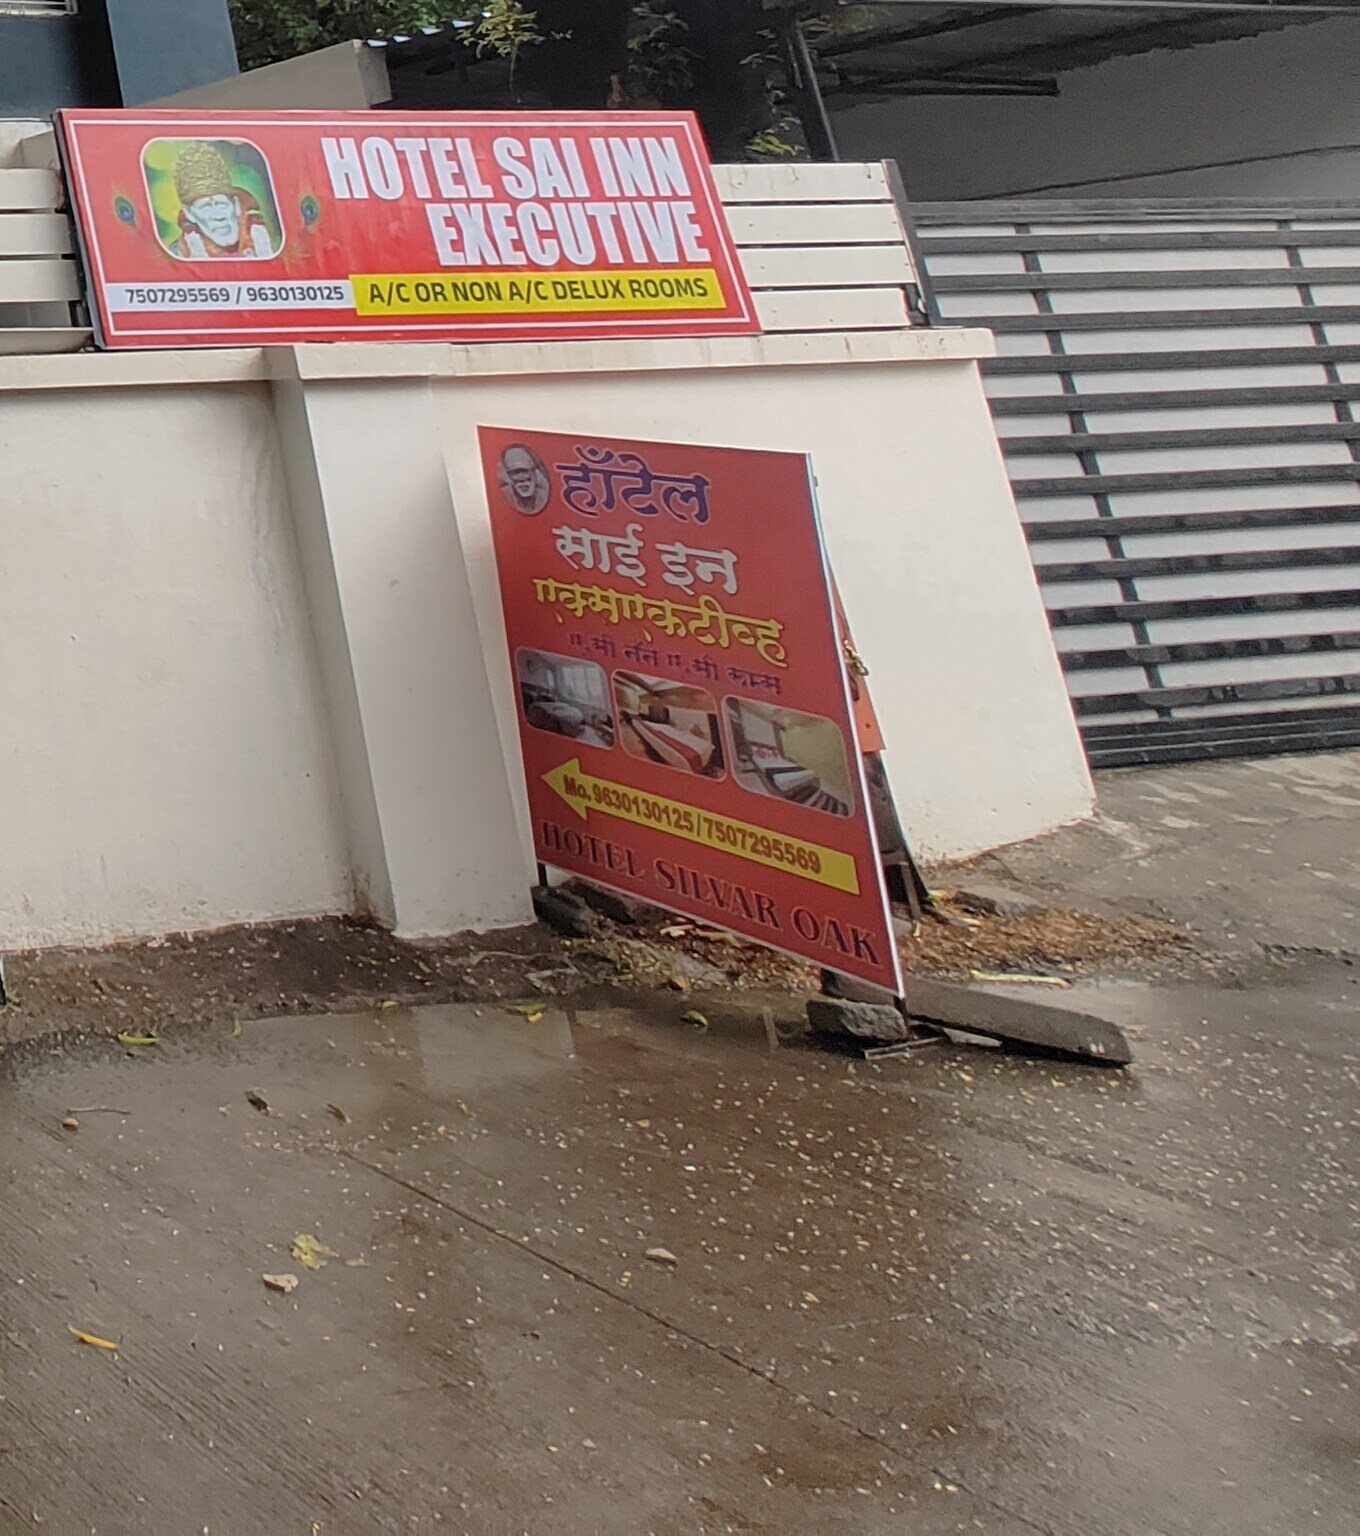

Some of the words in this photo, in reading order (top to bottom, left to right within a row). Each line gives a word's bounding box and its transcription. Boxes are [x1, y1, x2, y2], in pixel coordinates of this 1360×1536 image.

[320, 136, 493, 200] HOTEL
[492, 136, 591, 199] SAI
[589, 136, 692, 198] INN
[424, 201, 712, 265] EXECUTIVE
[125, 287, 230, 305] 7507295569
[246, 286, 344, 302] 9630130125
[369, 281, 411, 306] A/C
[415, 281, 447, 303] OR
[453, 280, 503, 302] NON
[508, 279, 549, 305] A/C
[554, 279, 626, 301] DELUX
[631, 277, 709, 299] ROOMS
[552, 523, 647, 587] साई
[655, 542, 738, 595] इन
[562, 773, 592, 801] Mo.
[542, 821, 645, 880] HOTEL
[654, 859, 784, 932] SILVAR
[792, 906, 884, 969] OAK
